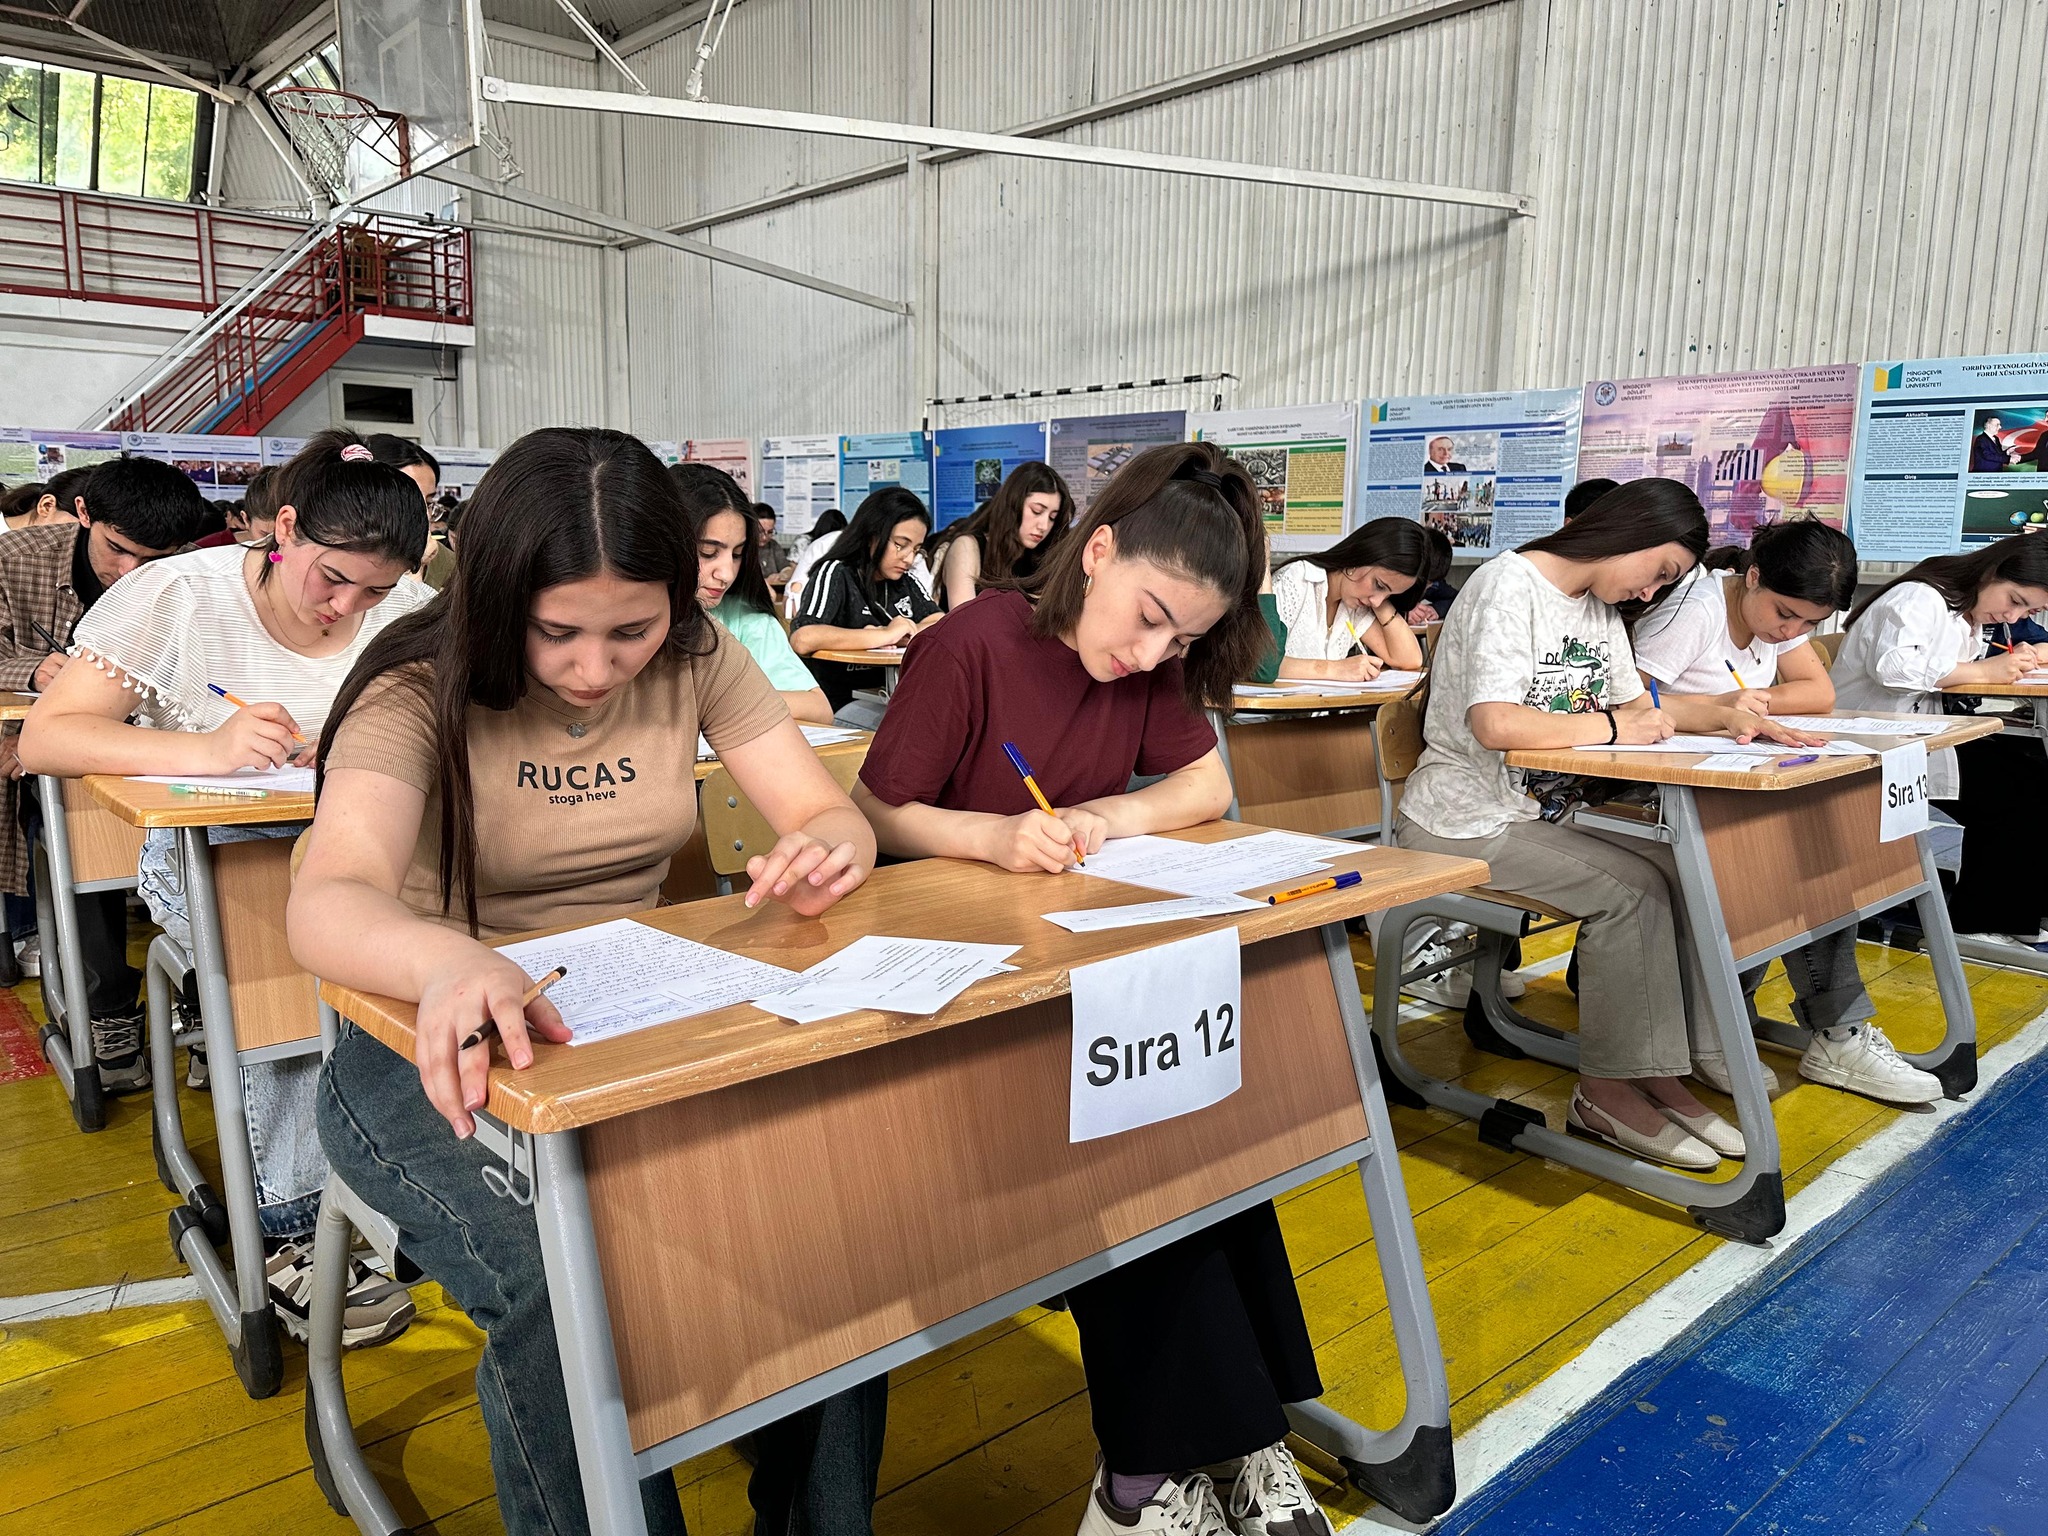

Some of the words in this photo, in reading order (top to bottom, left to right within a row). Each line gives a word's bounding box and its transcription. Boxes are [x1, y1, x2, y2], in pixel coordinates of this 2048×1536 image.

[517, 757, 636, 791] RUCAS
[1888, 783, 1914, 808] Sıra
[1916, 774, 1928, 800] 13
[549, 793, 583, 806] stoga
[586, 790, 617, 802] heve
[1086, 1032, 1181, 1087] Sıra
[1194, 1002, 1235, 1058] 12
